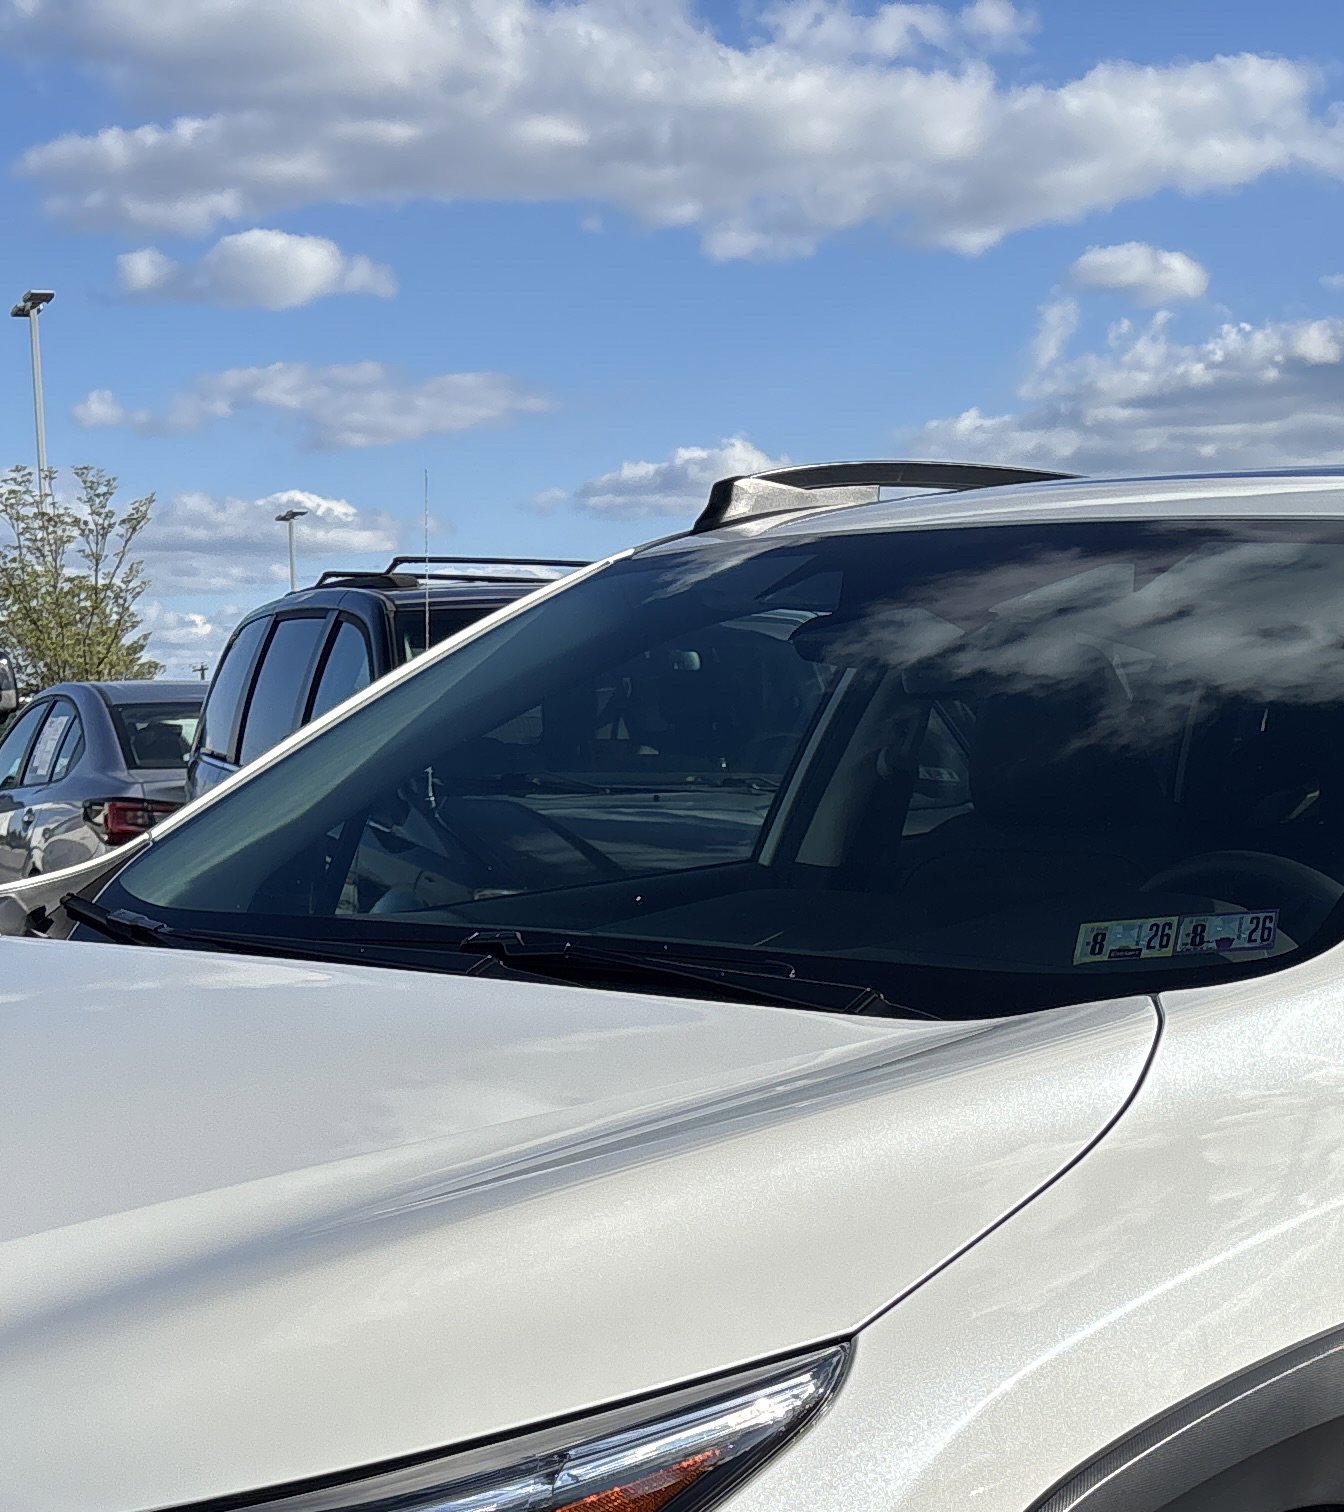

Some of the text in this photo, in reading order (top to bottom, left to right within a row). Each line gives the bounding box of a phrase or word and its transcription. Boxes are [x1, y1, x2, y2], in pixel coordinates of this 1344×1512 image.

[1089, 922, 1173, 956] 8 26
[1188, 915, 1274, 947] 8 26
